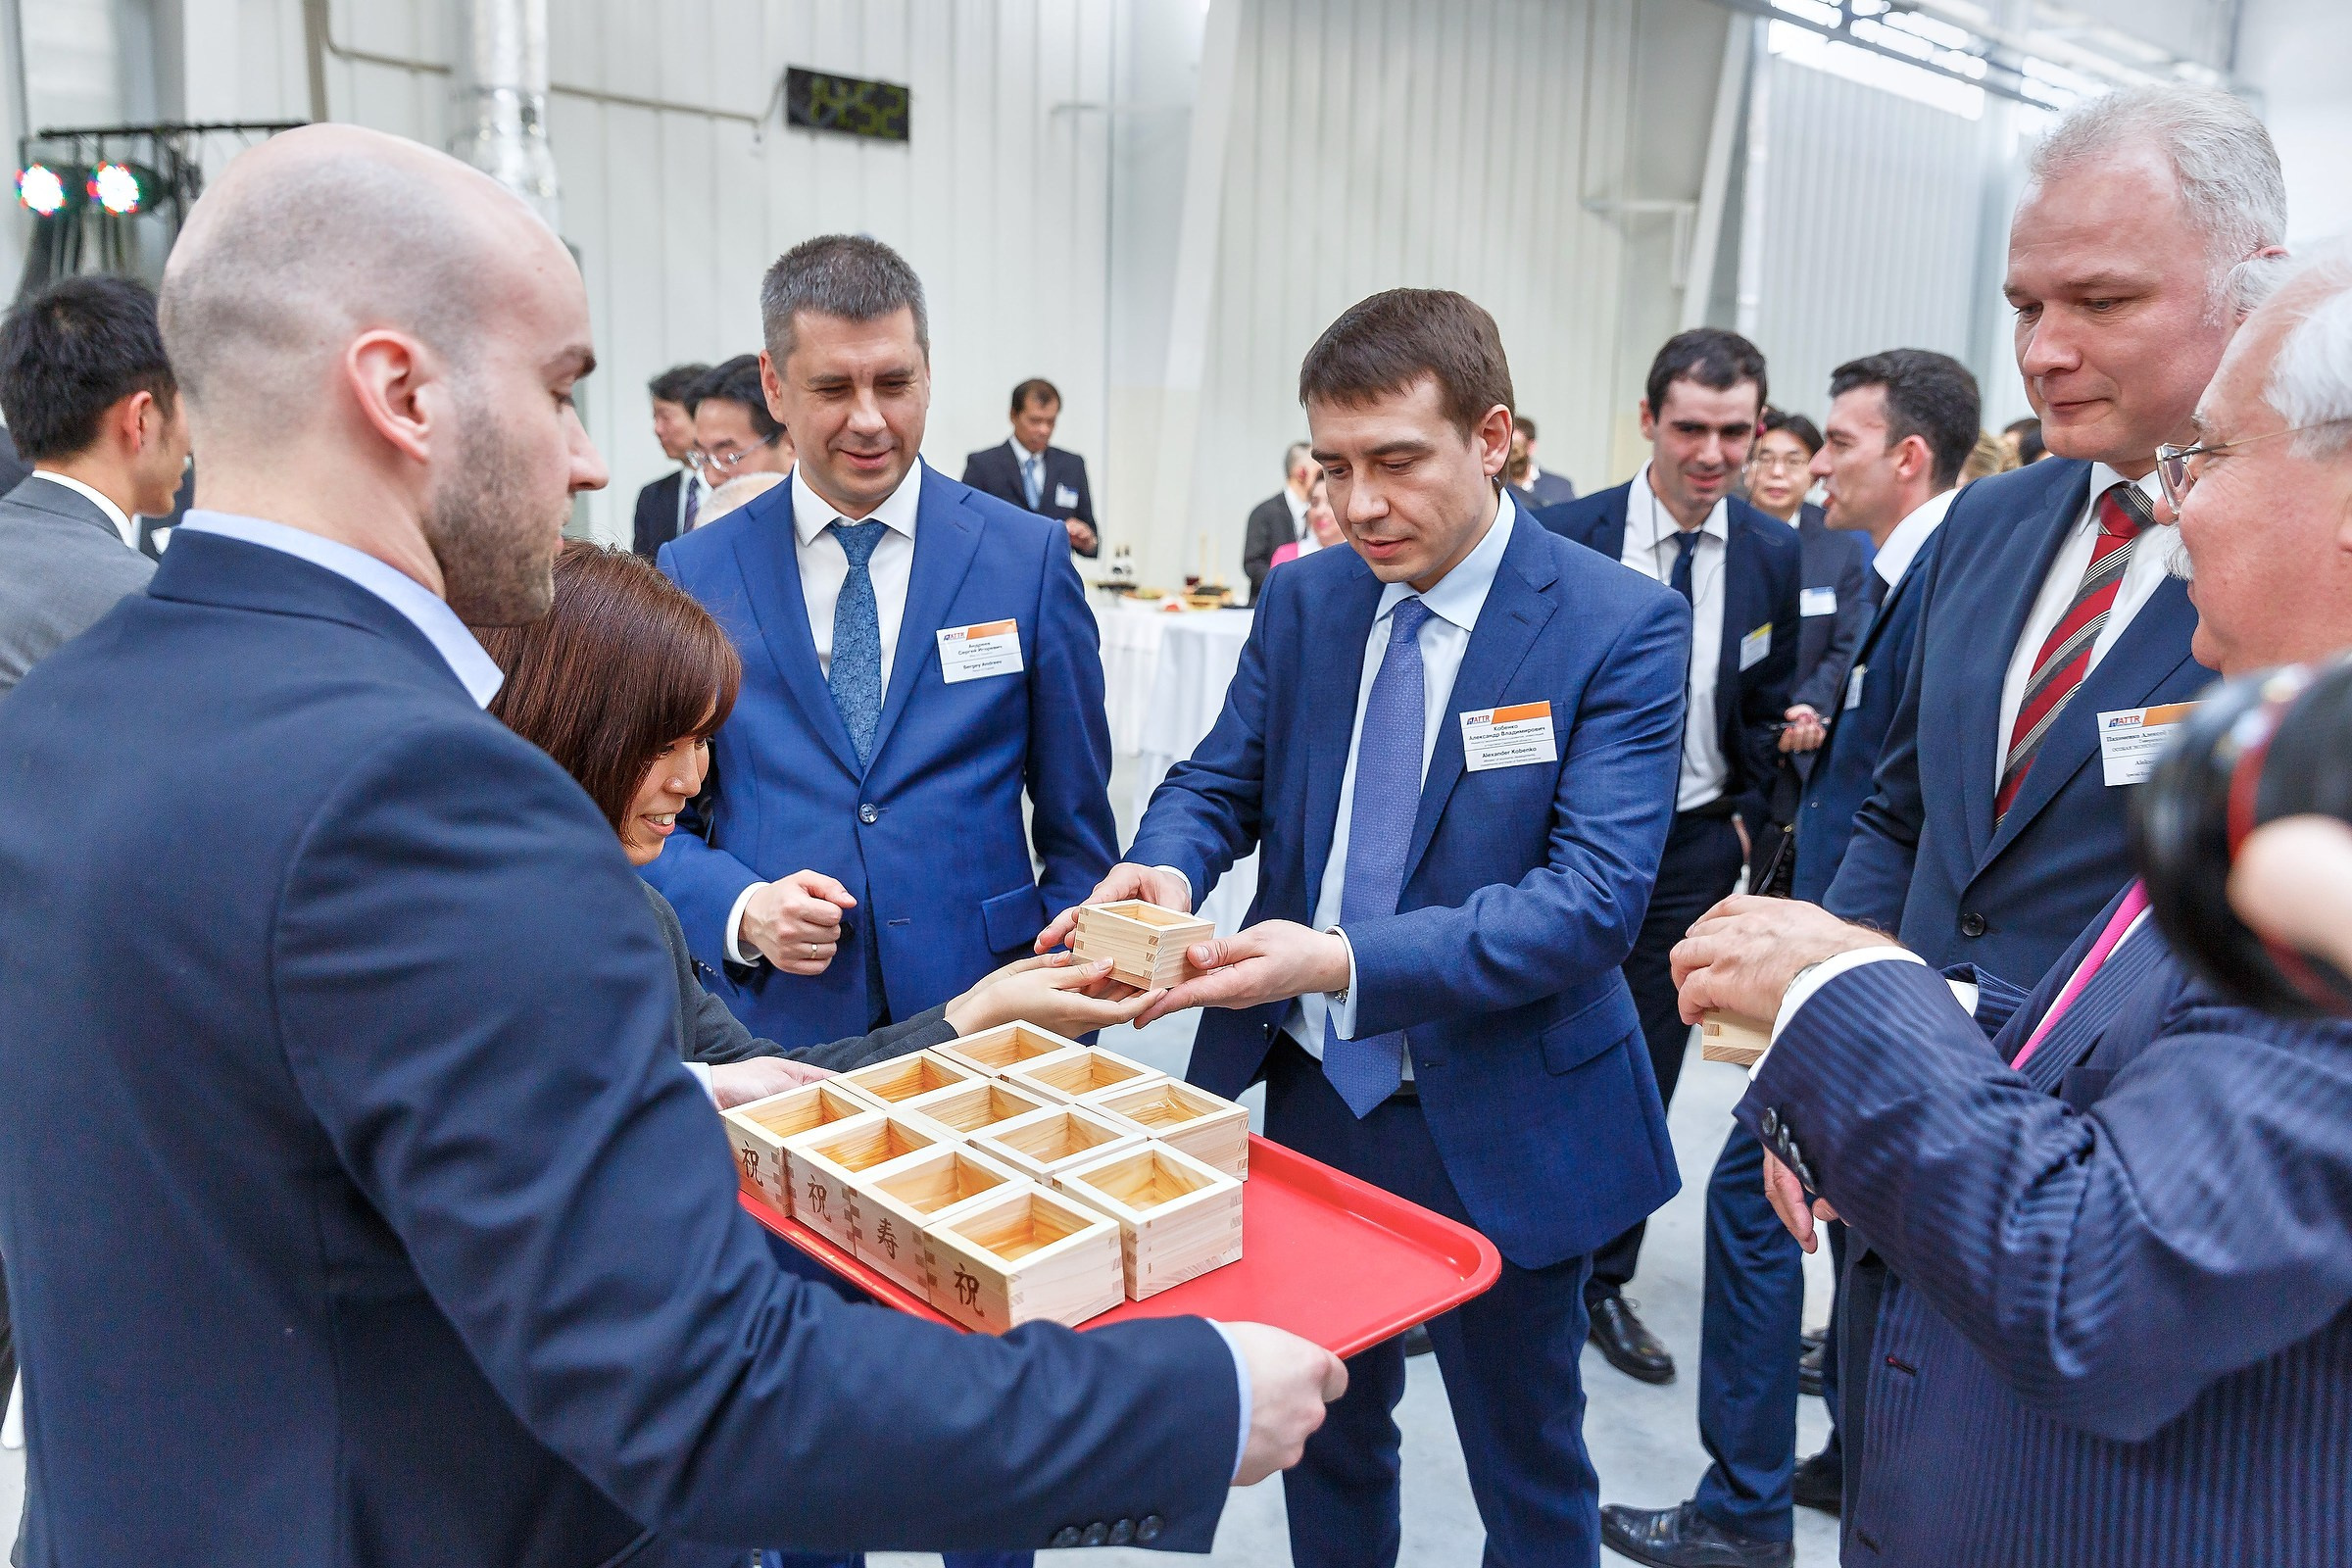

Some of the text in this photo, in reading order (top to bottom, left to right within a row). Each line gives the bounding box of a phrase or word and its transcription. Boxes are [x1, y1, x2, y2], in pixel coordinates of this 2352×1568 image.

[1473, 714, 1491, 723] ATTR
[2118, 714, 2141, 725] ATTR
[1469, 731, 1500, 741] Александр
[1500, 726, 1545, 737] Владимирович
[1482, 750, 1510, 759] Alexander
[741, 1140, 764, 1188] 祝
[808, 1174, 832, 1223] 祝
[877, 1217, 899, 1260] 寿
[954, 1262, 985, 1318] 祝
